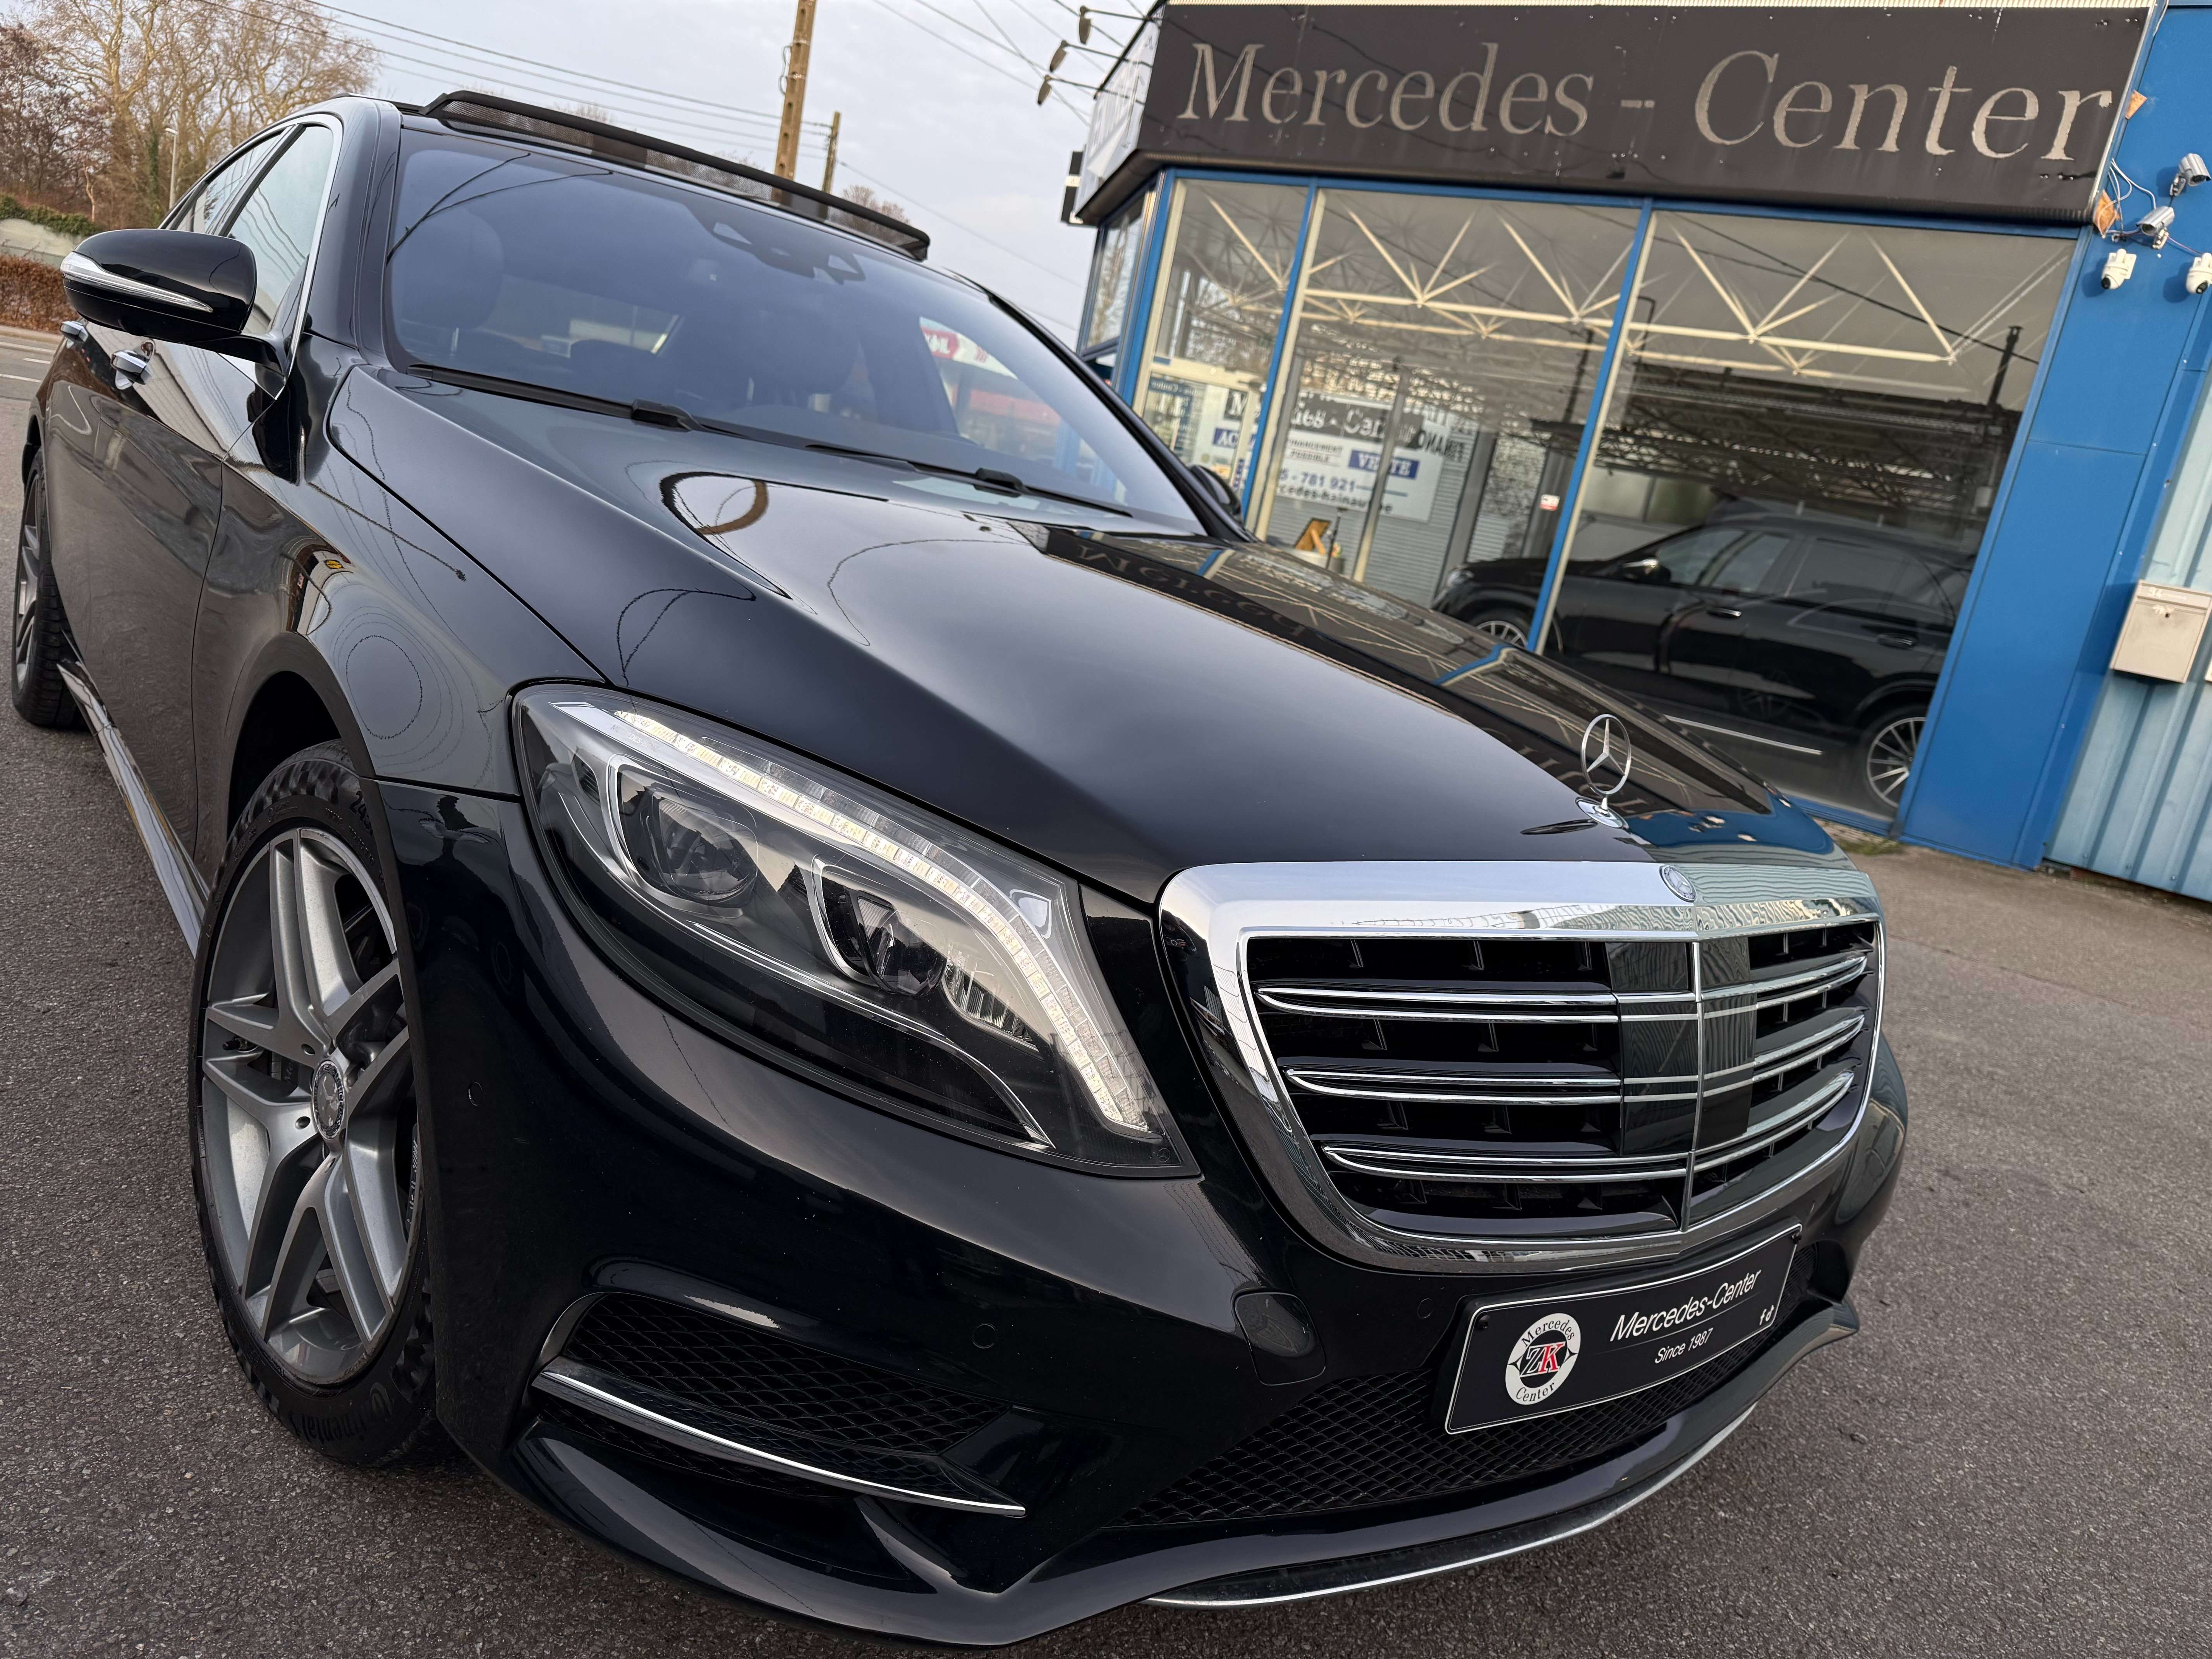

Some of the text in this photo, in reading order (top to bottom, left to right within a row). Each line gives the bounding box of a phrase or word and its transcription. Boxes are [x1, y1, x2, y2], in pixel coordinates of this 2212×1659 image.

[1176, 43, 2112, 161] Mercedes - Center
[1357, 452, 1413, 476] VETE
[1610, 1269, 1762, 1342] Mercedes-Center
[1521, 1319, 1575, 1348] Mercedes
[1655, 1328, 1714, 1364] Since 1987
[1519, 1341, 1566, 1378] ZK
[1516, 1382, 1555, 1402] Center
